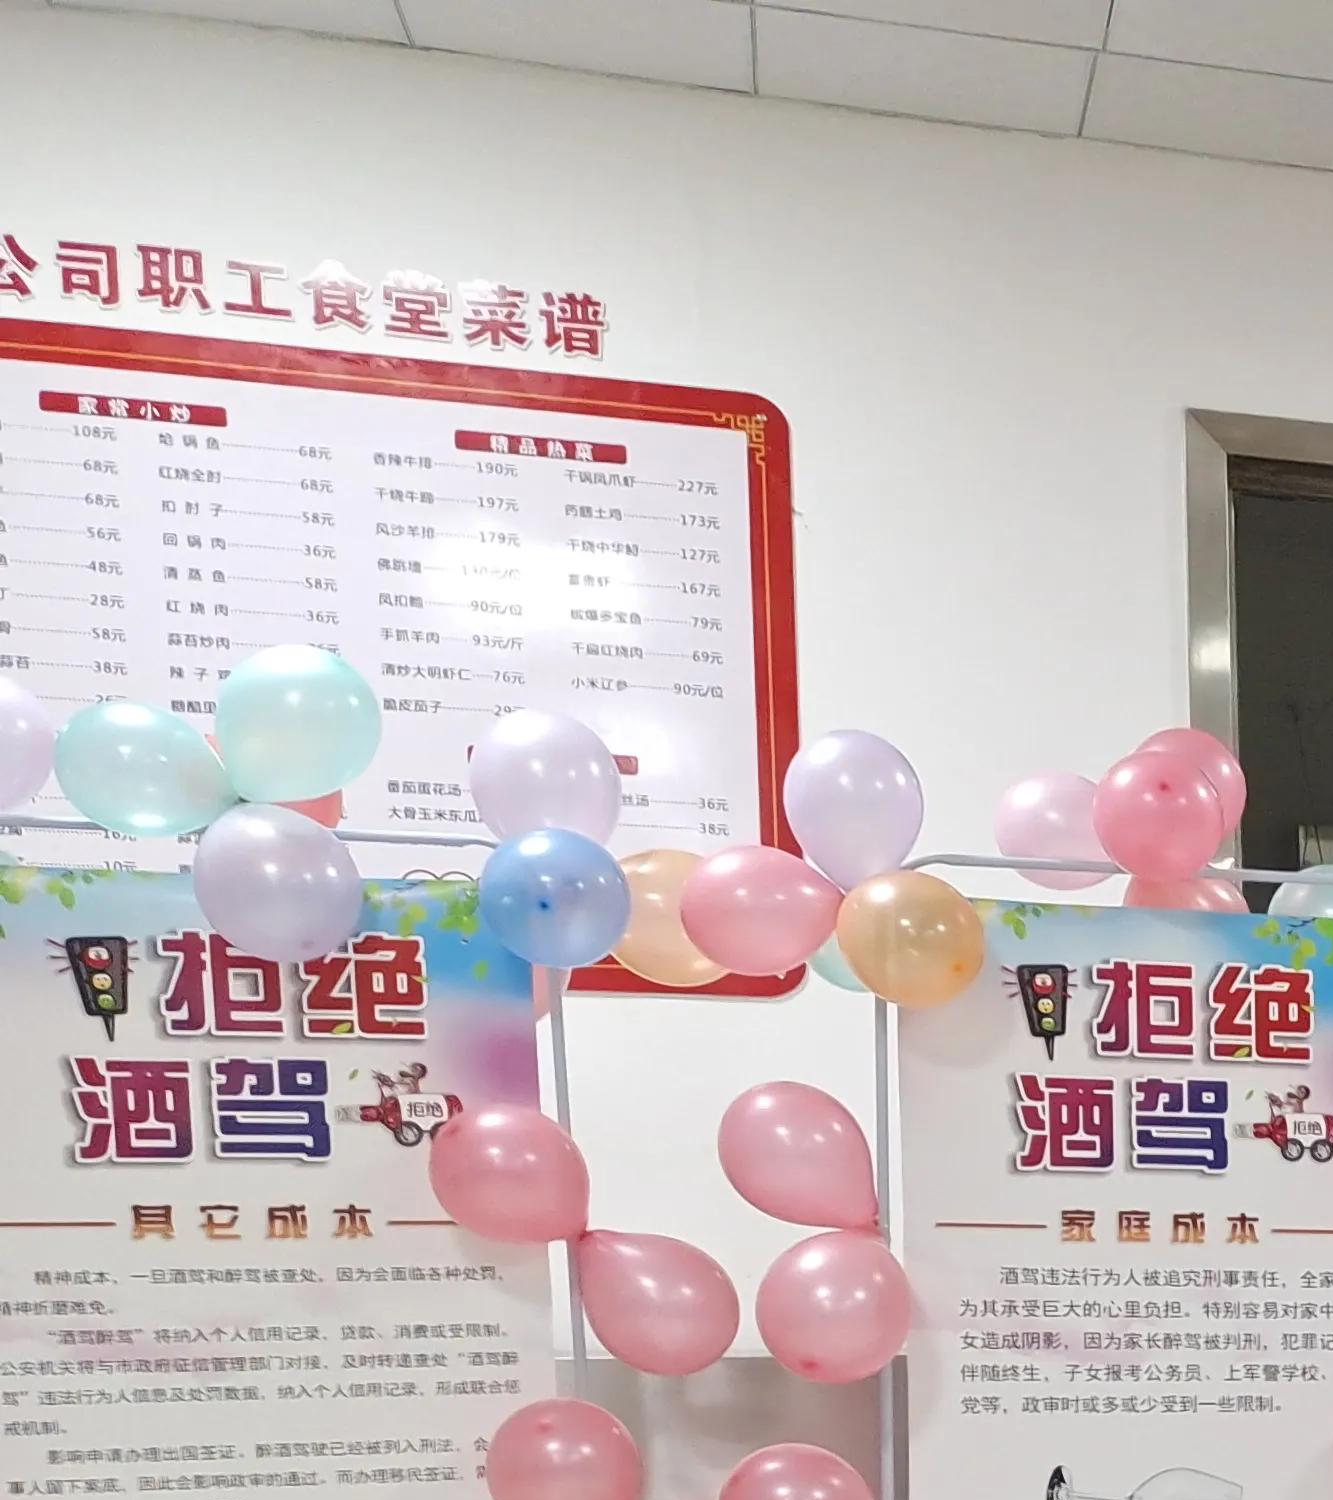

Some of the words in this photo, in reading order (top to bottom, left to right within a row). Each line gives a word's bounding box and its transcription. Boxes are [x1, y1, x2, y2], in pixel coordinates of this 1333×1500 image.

[0, 232, 608, 359] 公司职工食堂菜谱
[77, 395, 191, 423] 家常小炒
[72, 424, 117, 441] 108元
[298, 445, 332, 461] 68元
[83, 459, 118, 475] 68元
[476, 461, 518, 478] 190元
[300, 478, 334, 494] 68元
[677, 479, 719, 496] 227元
[85, 493, 120, 509] 68元
[477, 496, 519, 513] 197元
[302, 511, 335, 527] 58元
[680, 513, 720, 531] 173元
[86, 527, 121, 542] 56元
[479, 530, 520, 547] 179元
[163, 533, 226, 551] 回锅肉
[304, 544, 337, 559] 36元
[680, 547, 720, 565] 127元
[89, 561, 123, 576] 48元
[305, 577, 338, 592] 58元
[681, 581, 721, 598] 167元
[89, 594, 124, 609] 28元
[166, 600, 229, 617] 红烧肉
[306, 610, 340, 626] 36元
[690, 616, 723, 632] 79元
[92, 627, 126, 643] 58元
[380, 627, 440, 645] 手抓羊肉
[472, 633, 524, 651] 93元/斤
[692, 649, 724, 666] 69元
[94, 660, 128, 676] 38元
[382, 662, 472, 682] 清炒大明虾仁
[493, 669, 526, 685] 76元
[673, 682, 724, 699] 90元/位
[387, 779, 463, 797] 番茄蛋花汤
[698, 797, 729, 812] 36元
[388, 806, 486, 824] 大骨玉米东瓜
[698, 822, 730, 838] 38元
[157, 929, 428, 1040] 拒绝
[1093, 958, 1315, 1065] 拒绝
[70, 1054, 332, 1165] 酒驾
[1014, 1071, 1230, 1176] 酒驾
[1292, 1119, 1323, 1137] 拒绝
[131, 1204, 374, 1240] 其它成本
[1061, 1208, 1260, 1244] 家庭成本
